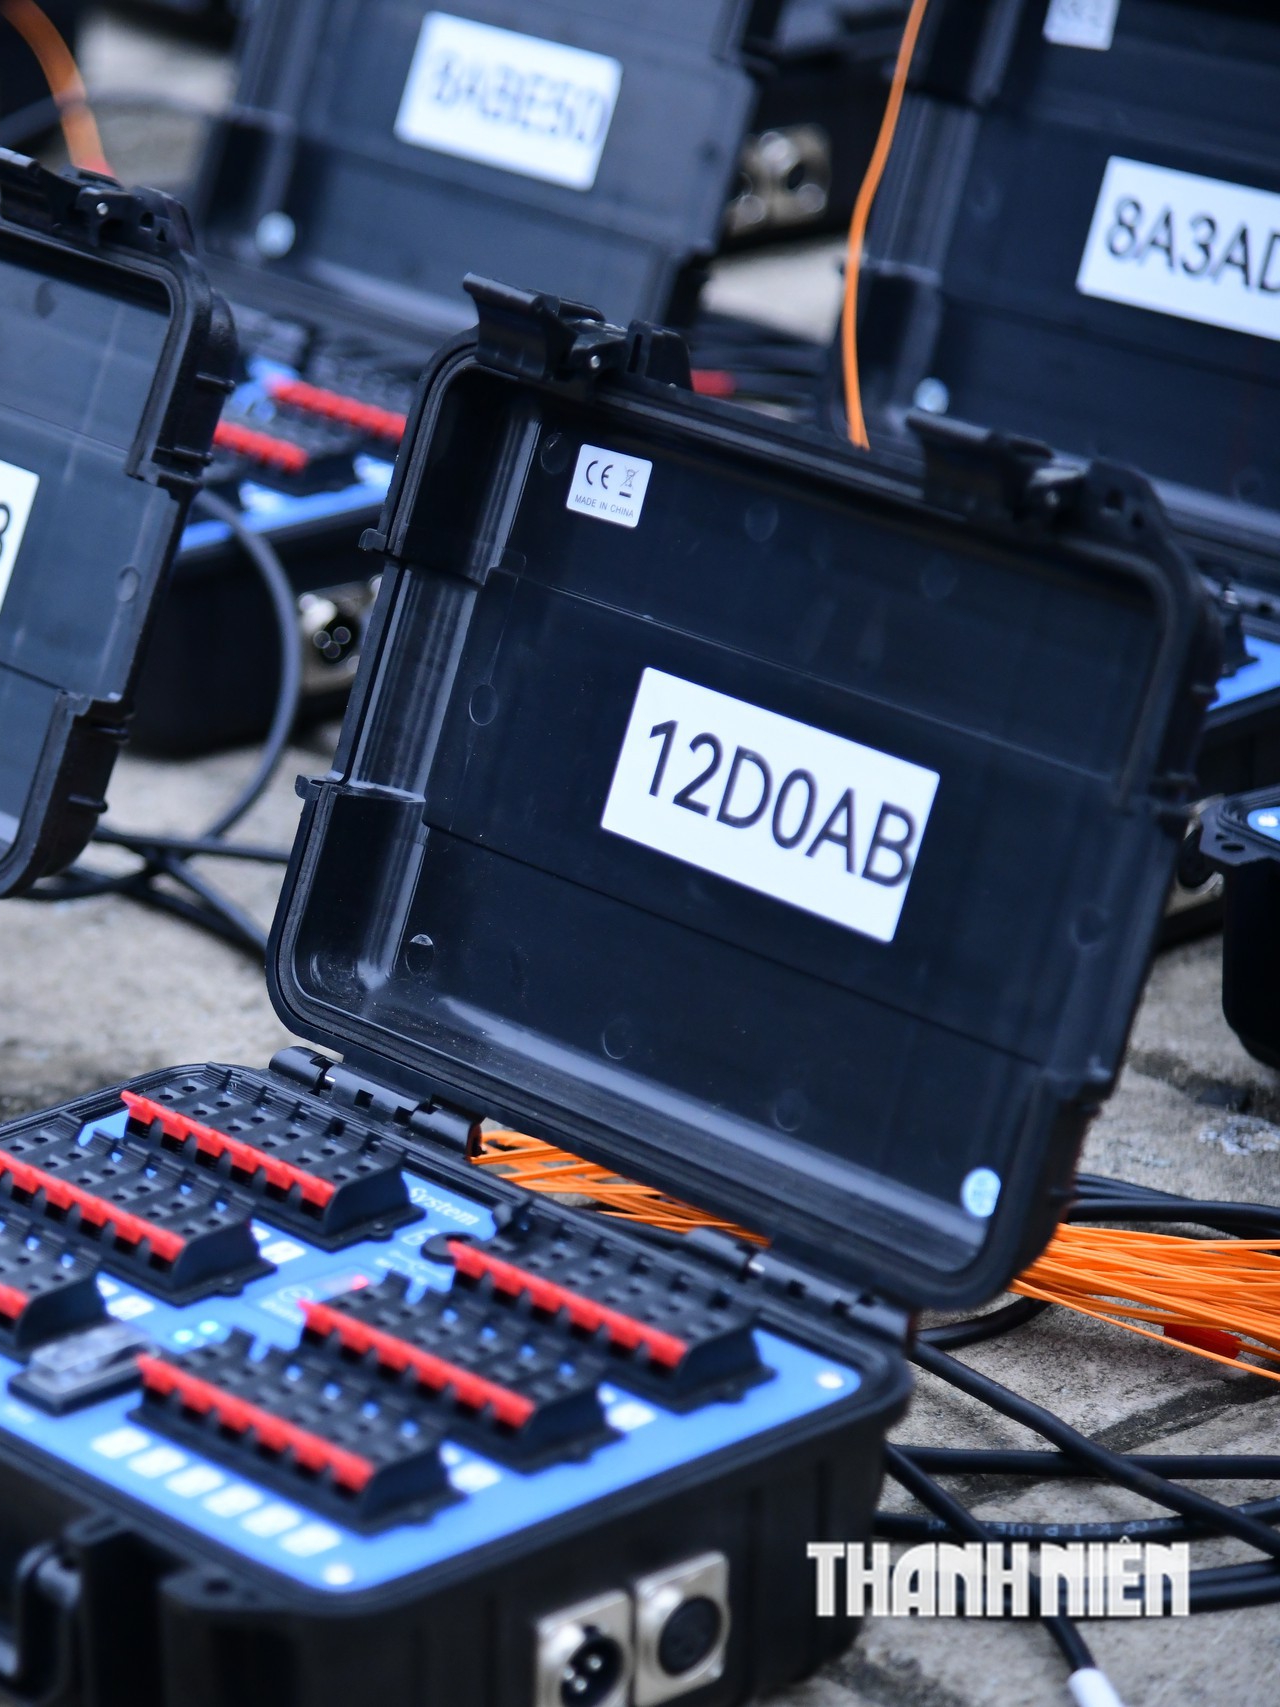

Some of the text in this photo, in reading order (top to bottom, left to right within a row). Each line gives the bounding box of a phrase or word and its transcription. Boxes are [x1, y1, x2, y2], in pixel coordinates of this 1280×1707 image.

[586, 460, 614, 490] CE
[575, 494, 634, 518] MADE IN CHINA
[648, 719, 917, 888] 12D0AB
